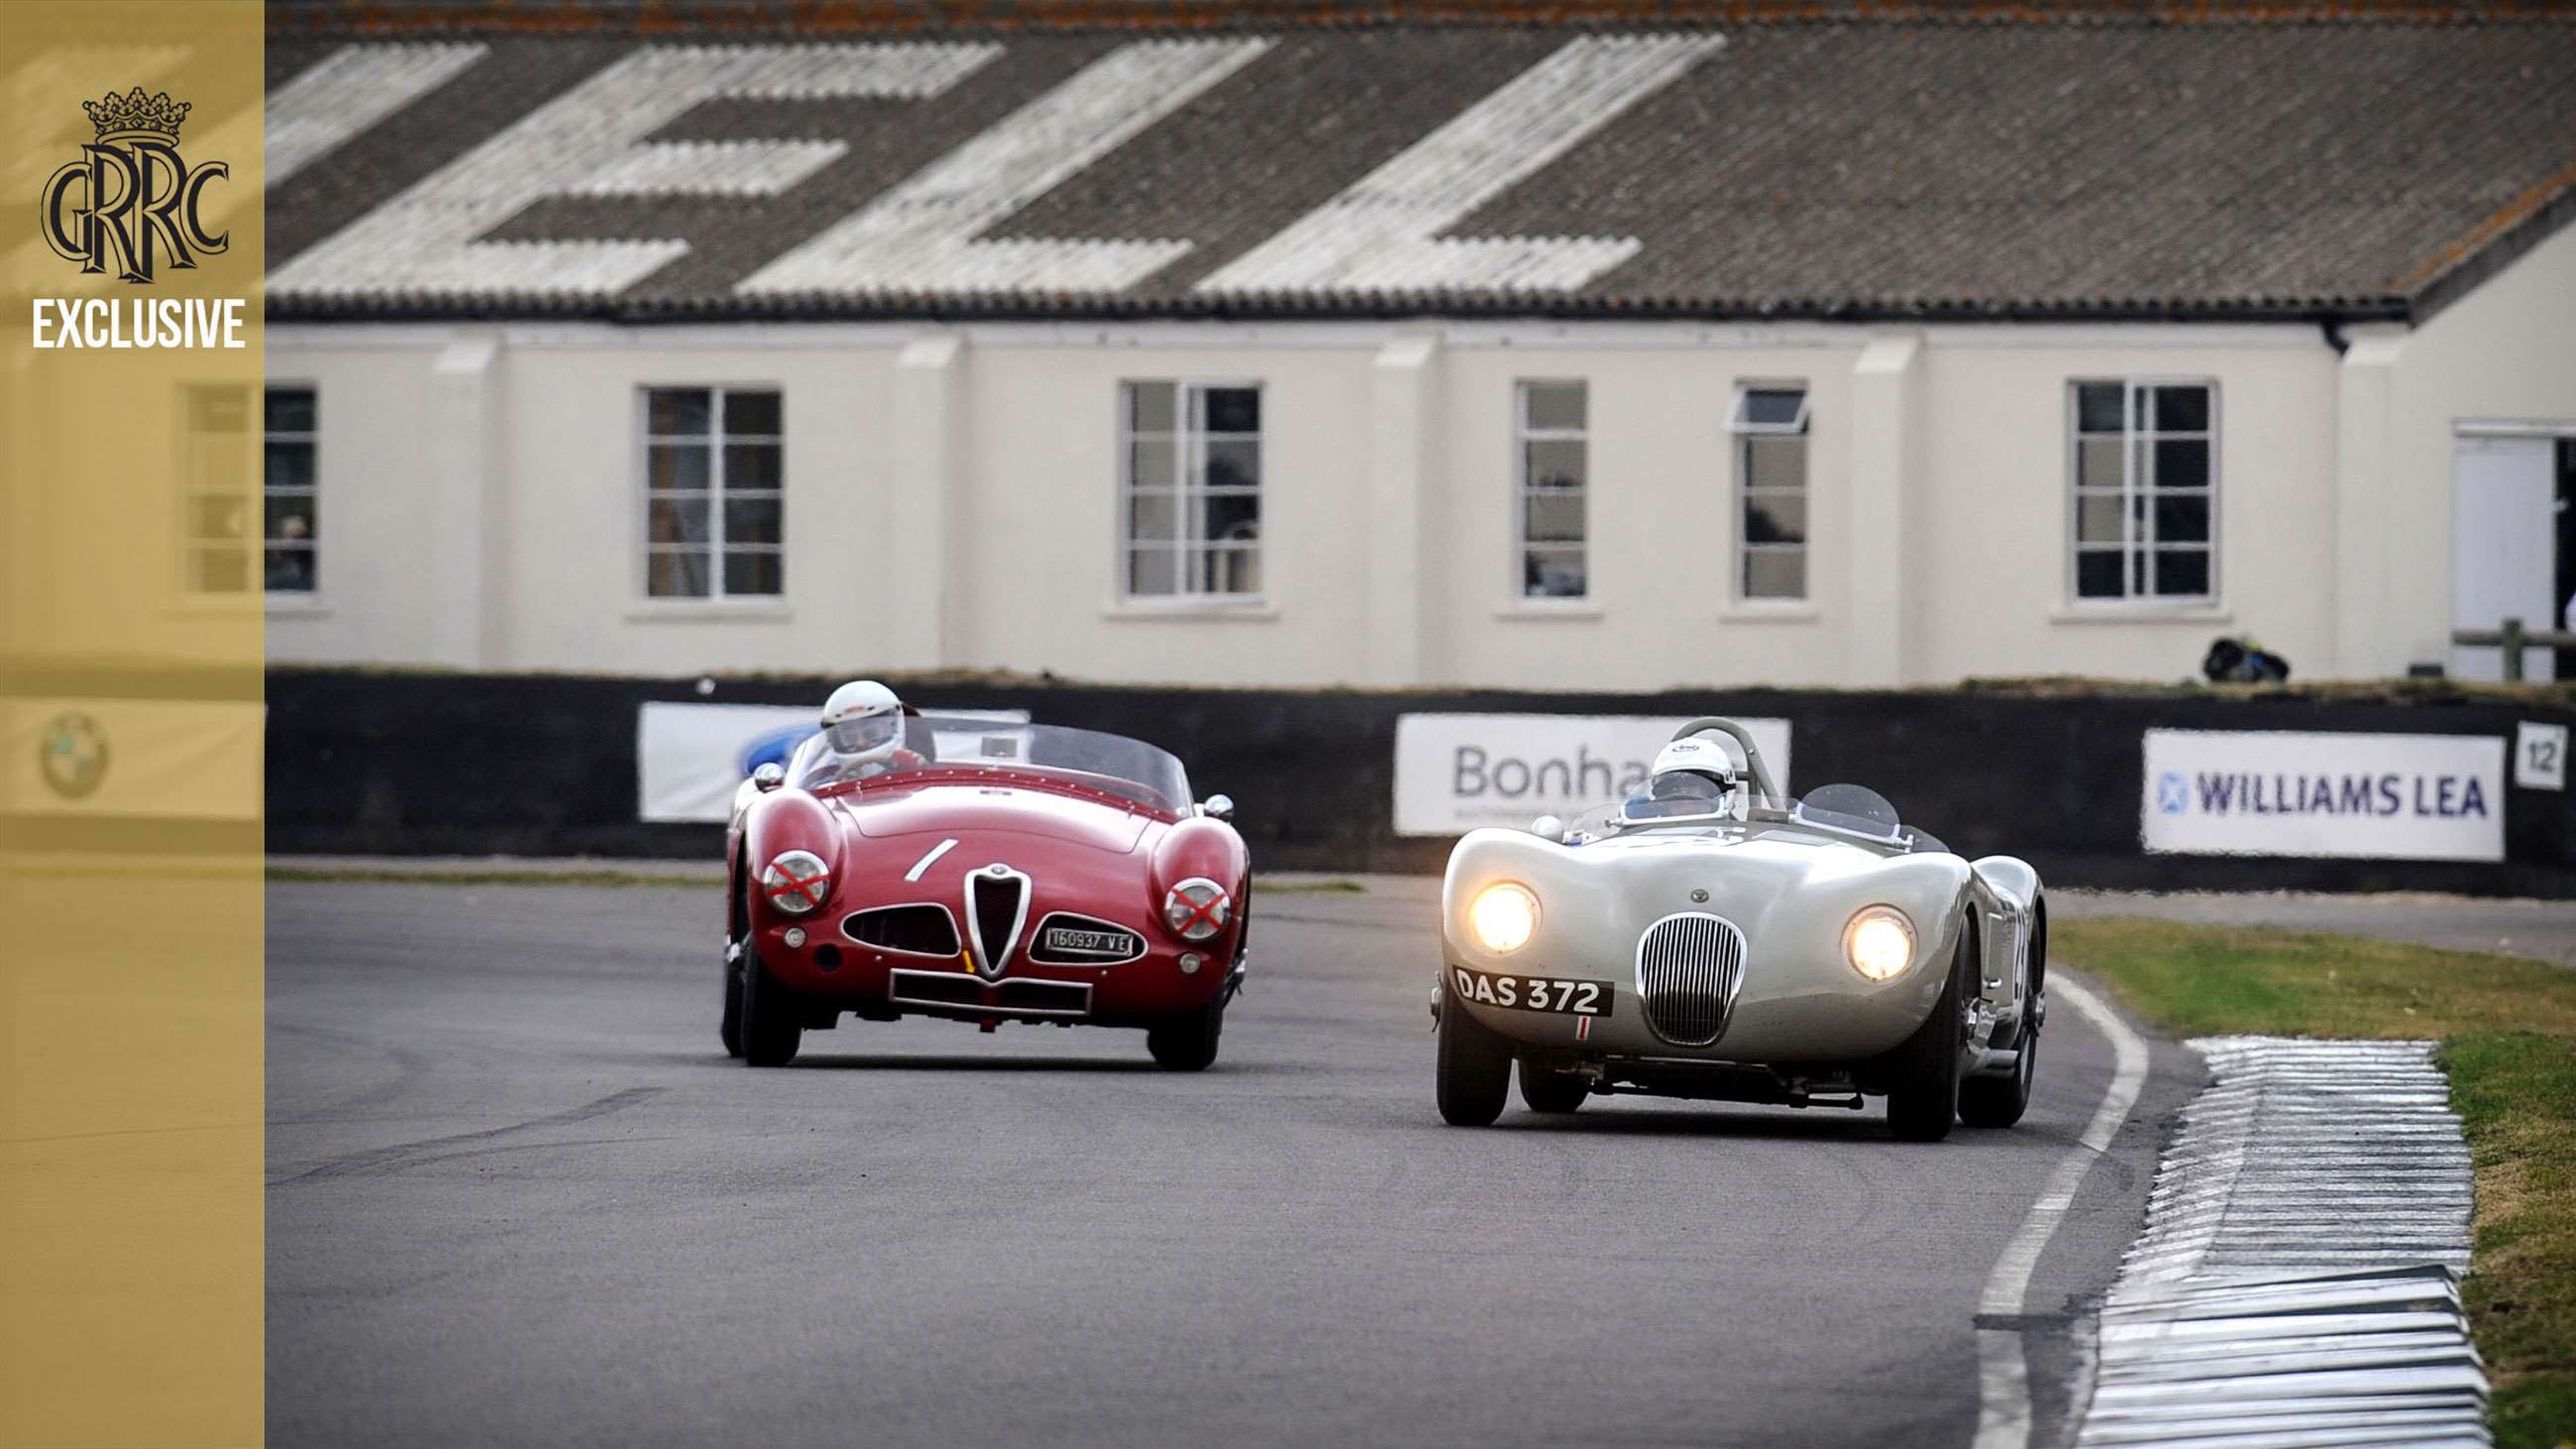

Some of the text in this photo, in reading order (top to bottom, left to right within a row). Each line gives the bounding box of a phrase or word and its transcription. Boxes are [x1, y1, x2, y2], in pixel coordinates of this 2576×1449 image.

[1454, 746, 1652, 800] Bonha
[2527, 741, 2556, 773] 12
[2197, 773, 2488, 818] WILLIAMS LEA
[1053, 931, 1101, 949] 160937
[1455, 969, 1599, 1013] DAS 372
